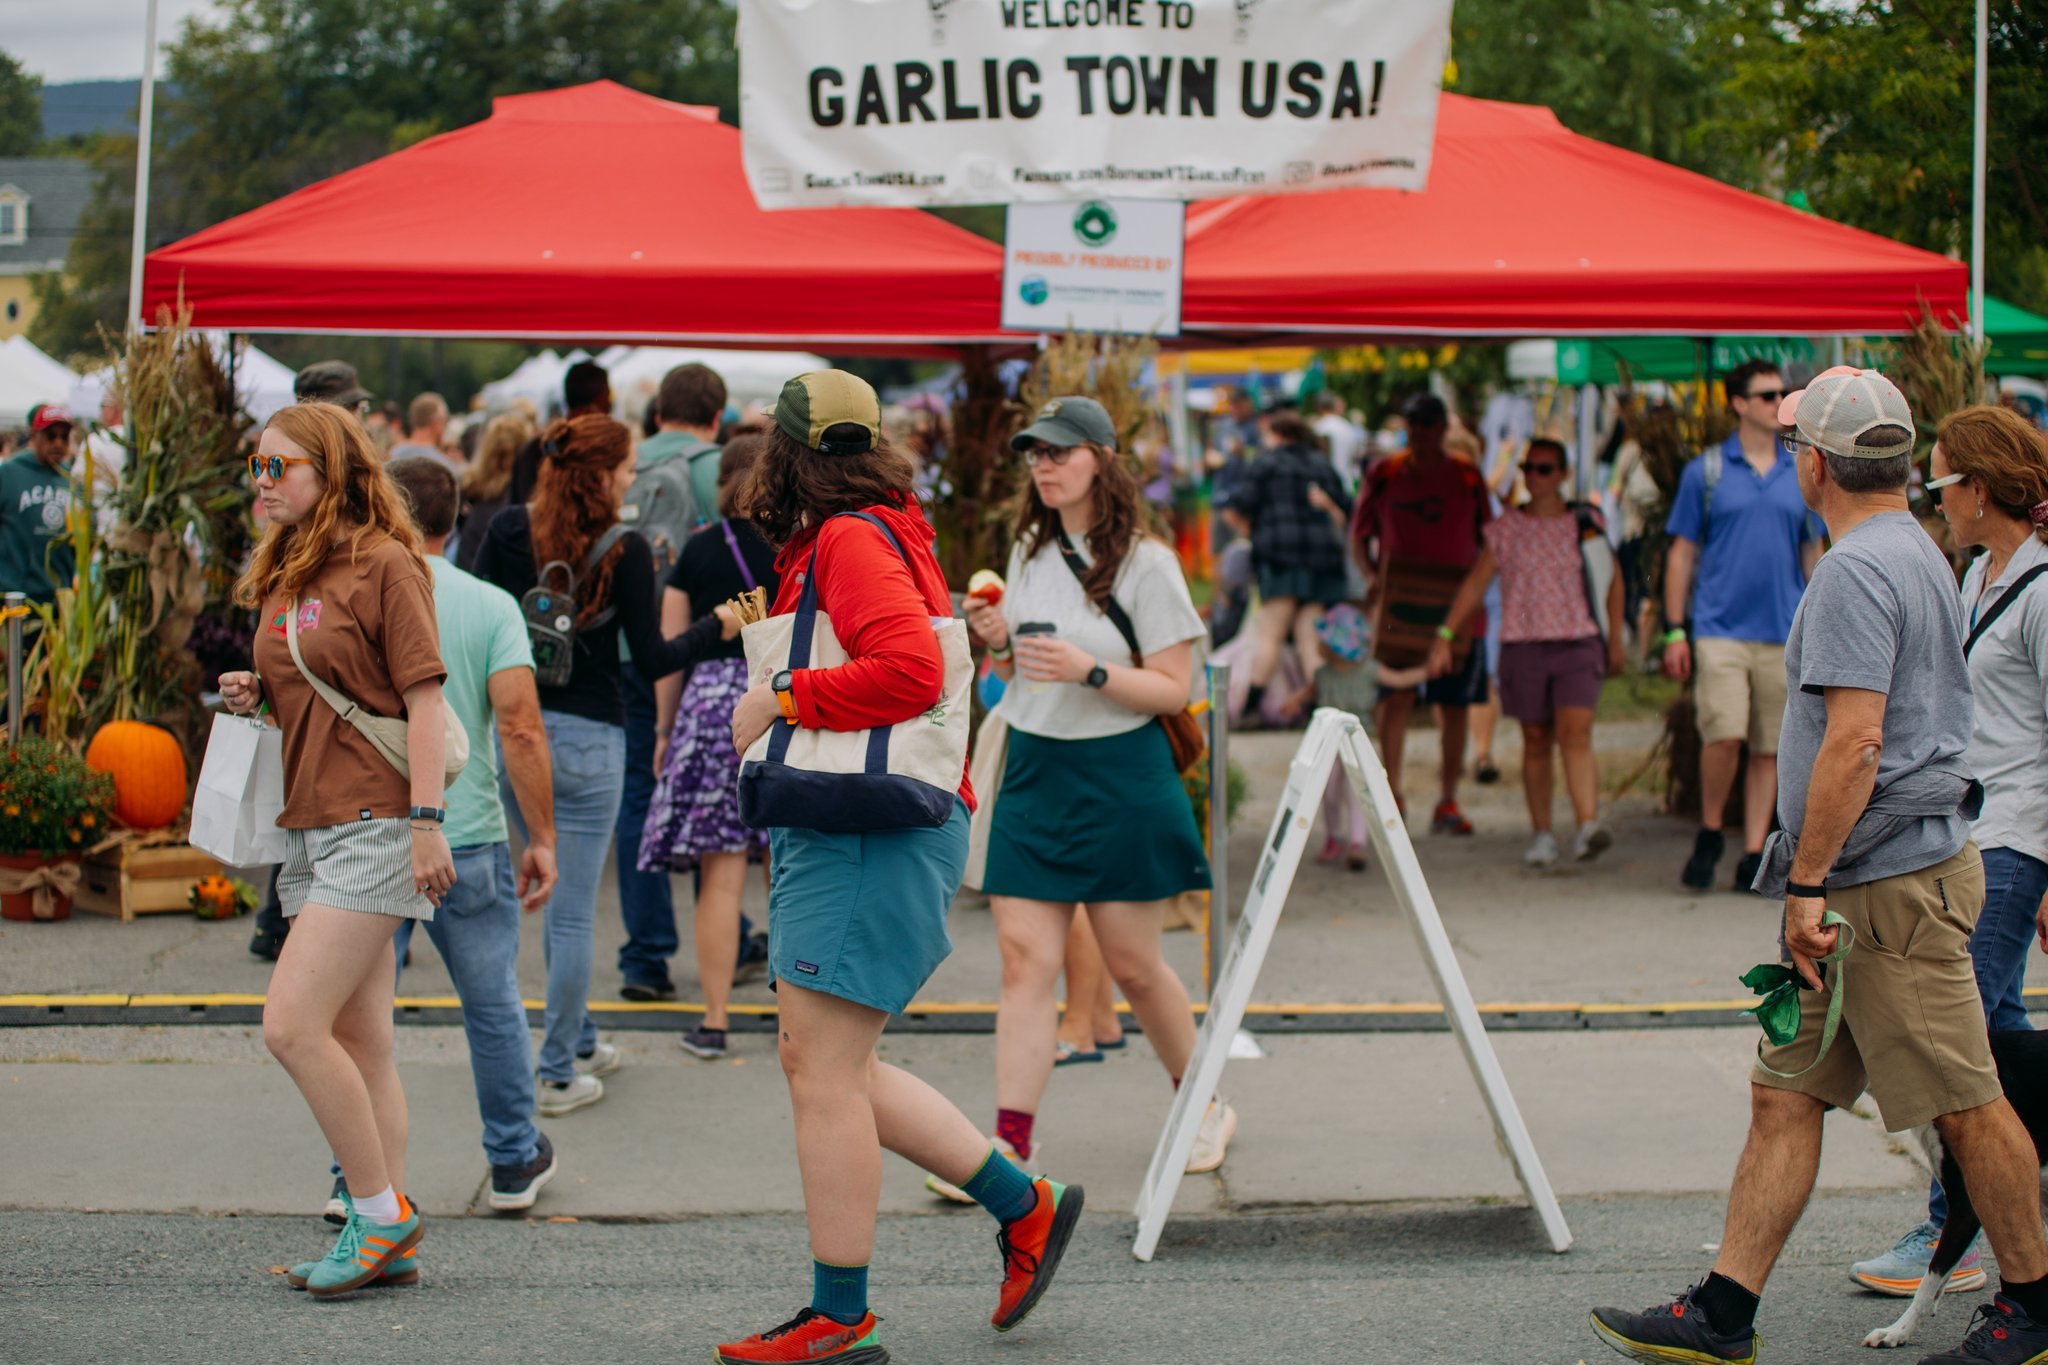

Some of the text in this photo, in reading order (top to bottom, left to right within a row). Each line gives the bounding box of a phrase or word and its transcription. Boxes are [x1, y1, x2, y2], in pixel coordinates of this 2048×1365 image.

[1000, 0, 1194, 29] WELCOME TO
[808, 55, 1386, 128] GARLIC TOWN USA!
[807, 1328, 859, 1355] HOKA
